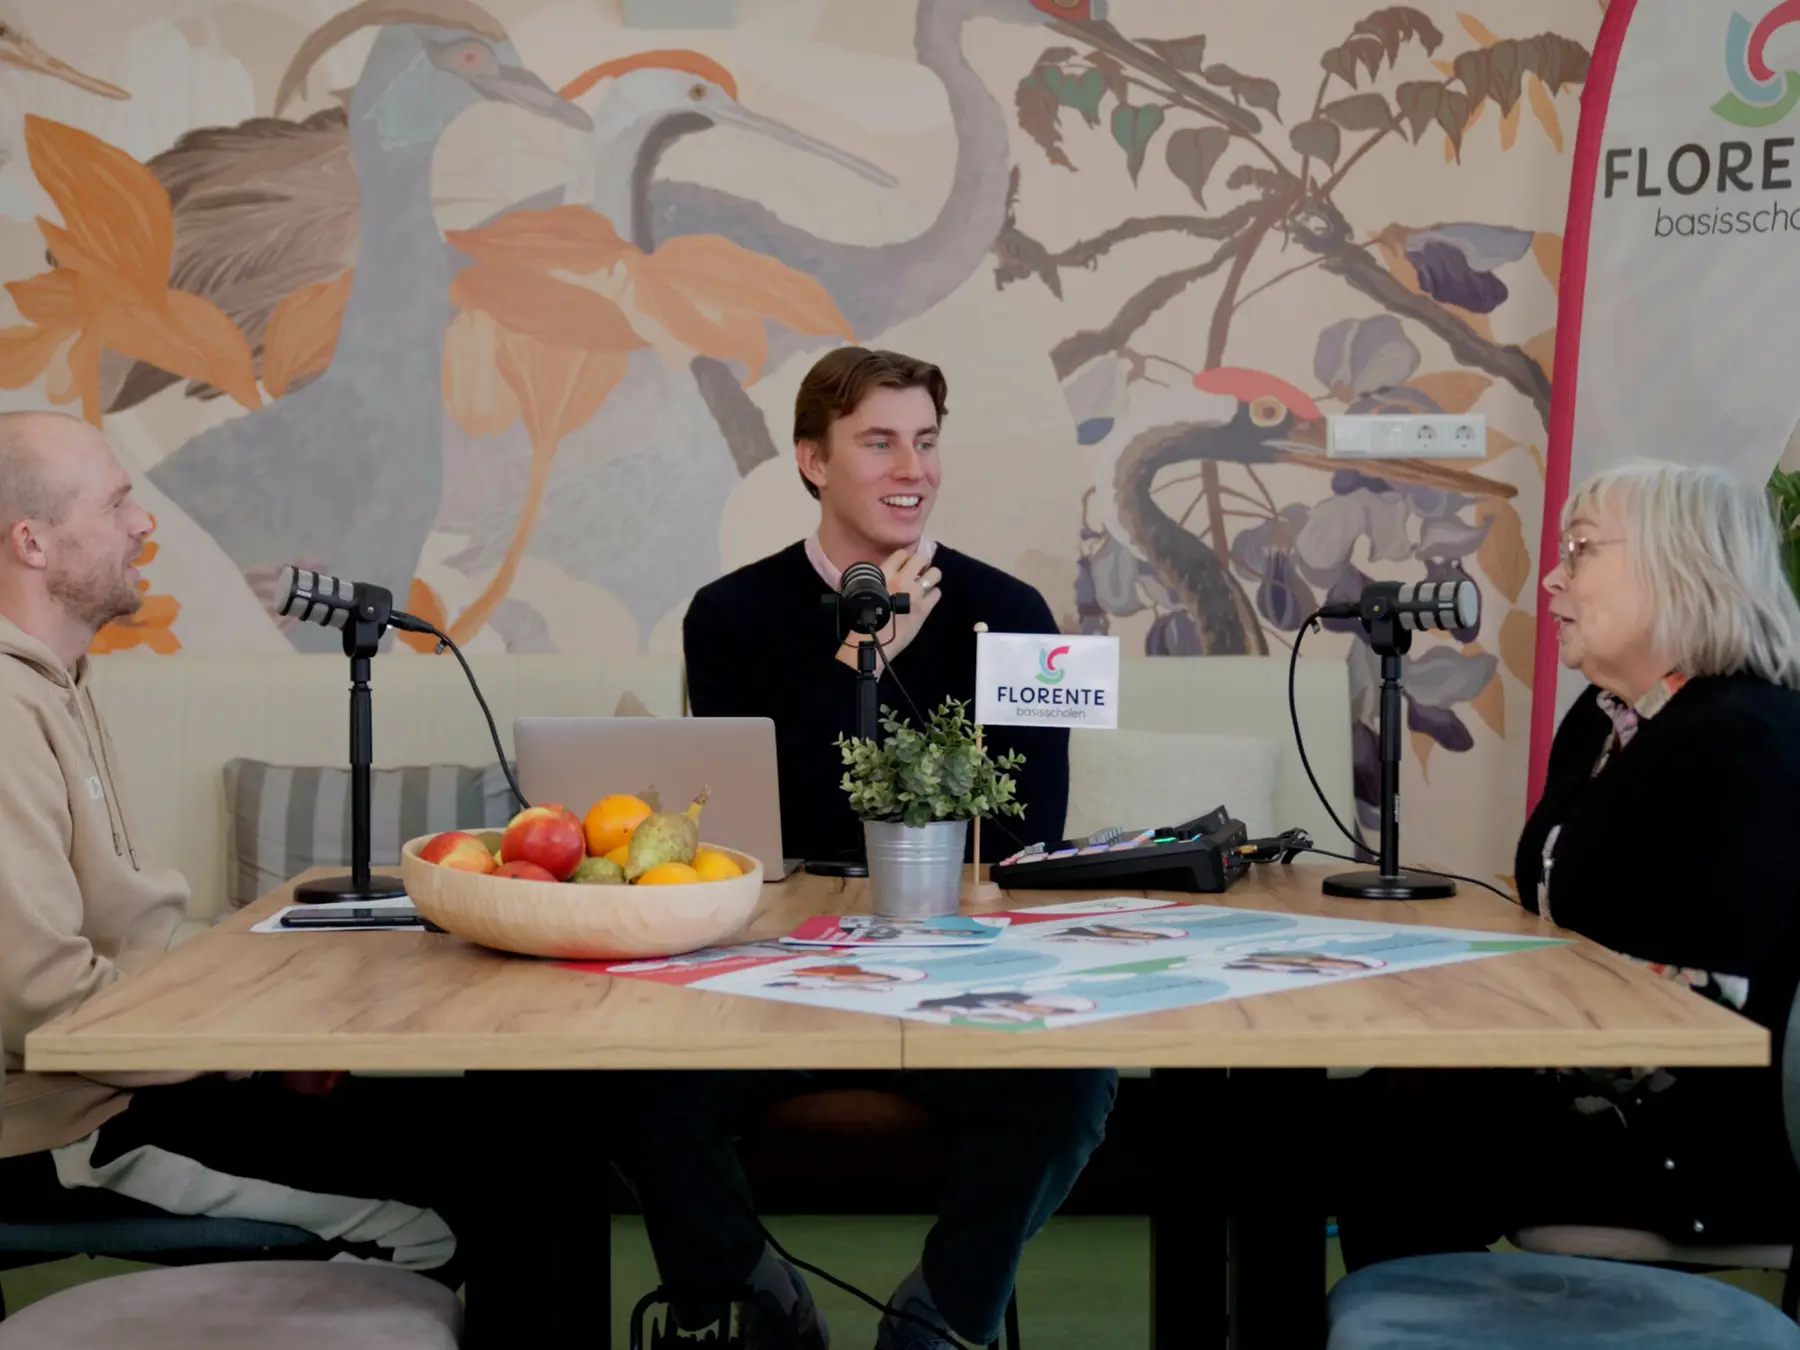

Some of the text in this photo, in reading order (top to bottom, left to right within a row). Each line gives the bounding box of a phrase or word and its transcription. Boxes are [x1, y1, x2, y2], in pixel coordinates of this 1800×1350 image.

[1604, 137, 1795, 198] FLORE
[997, 686, 1105, 706] FLORENTE
[1016, 705, 1086, 719] basisscholen
